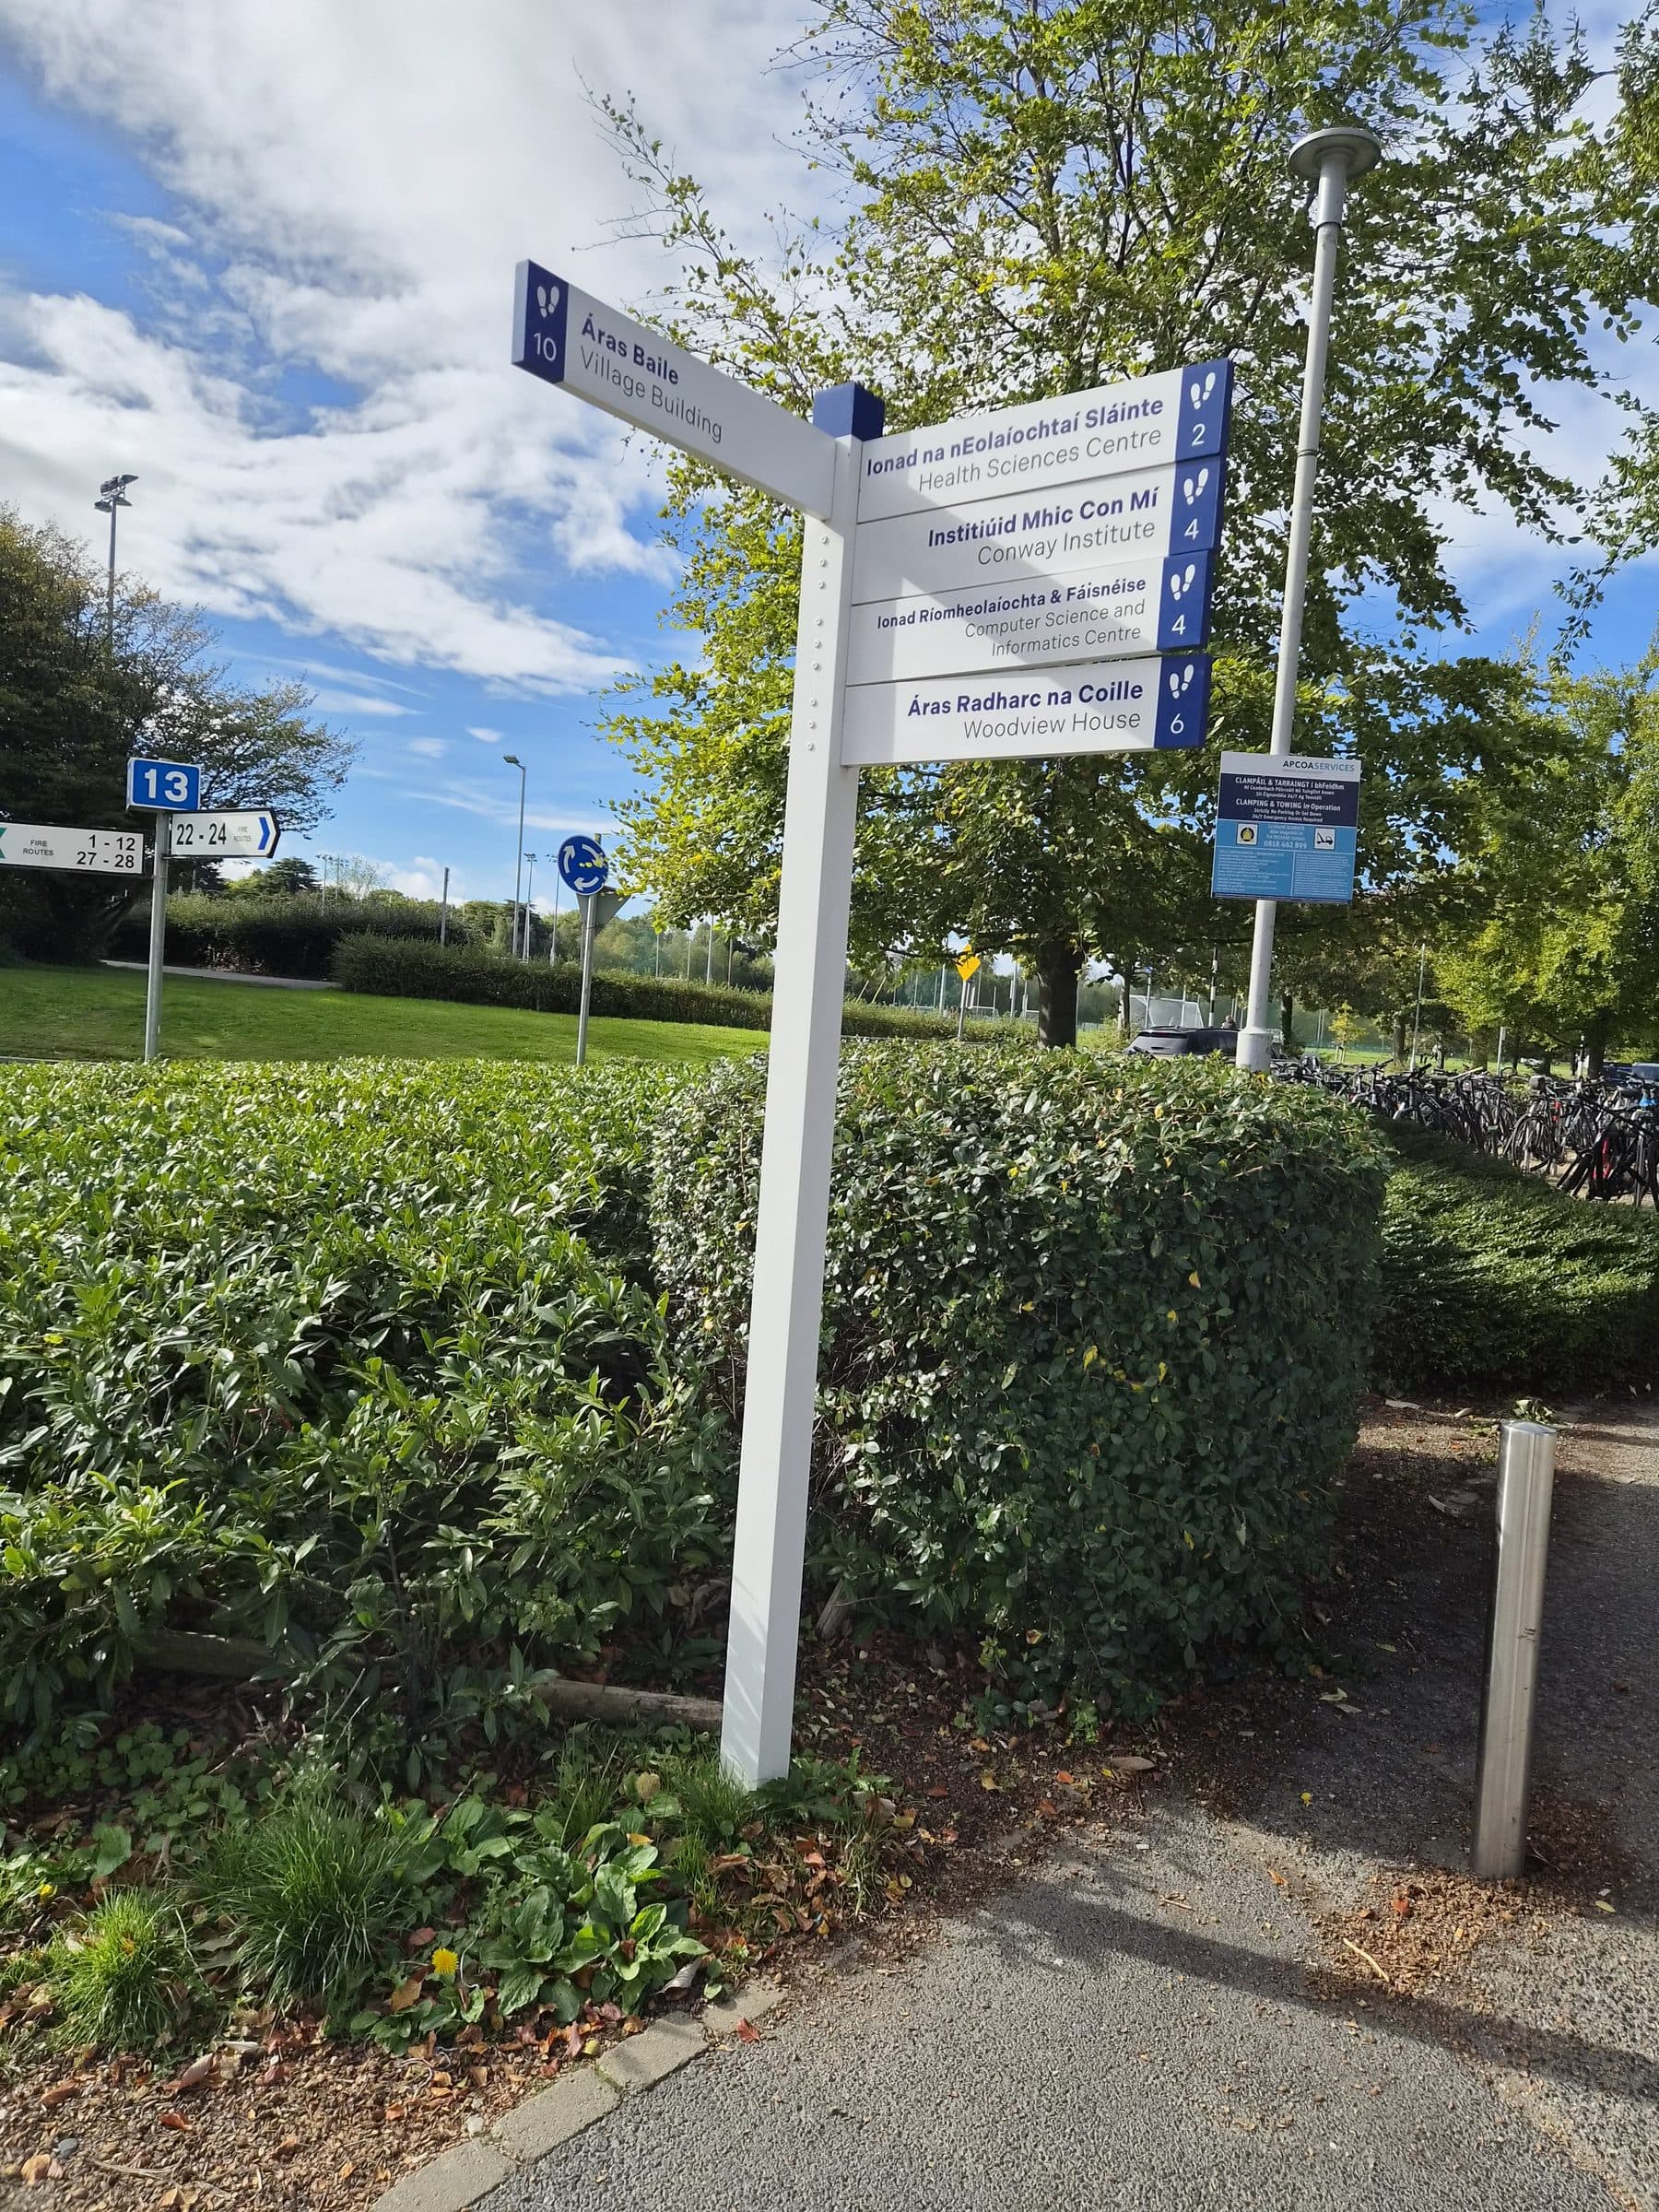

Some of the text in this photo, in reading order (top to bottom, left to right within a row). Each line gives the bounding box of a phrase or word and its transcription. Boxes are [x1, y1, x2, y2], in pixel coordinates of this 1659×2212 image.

[533, 333, 557, 361] 10
[582, 312, 678, 385] Áras Baile
[581, 346, 723, 443] Village Building
[867, 397, 1164, 476] Ionad na nEolaíochtaí Sláinte
[1191, 423, 1206, 447] 2
[919, 428, 1162, 492] Health Sciences Centre
[929, 487, 1160, 547] Institiúid Mhic Con Mí
[1184, 518, 1199, 541] 4
[978, 520, 1156, 565] Conway Institute
[877, 577, 1147, 629] Ionad Ríomheolaíochta & Fáisnéise
[965, 599, 1145, 640] Computer Science and
[1171, 614, 1186, 636] 4
[992, 626, 1141, 657] Informatics Centre
[908, 680, 1144, 717] Áras Radharc na Coille
[963, 710, 1141, 739] Woodview House
[1170, 712, 1184, 735] 6
[144, 769, 189, 802] 13
[1236, 798, 1269, 807] CLAMPING
[1277, 801, 1302, 809] TOWING
[1311, 803, 1341, 812] Operation
[30, 839, 48, 847] FIRE
[89, 834, 97, 849] 1
[116, 836, 135, 852] 12
[176, 823, 194, 845] 22
[208, 822, 228, 845] 24
[22, 848, 54, 857] ROUTES
[76, 851, 97, 865] 27
[114, 853, 135, 868] 28
